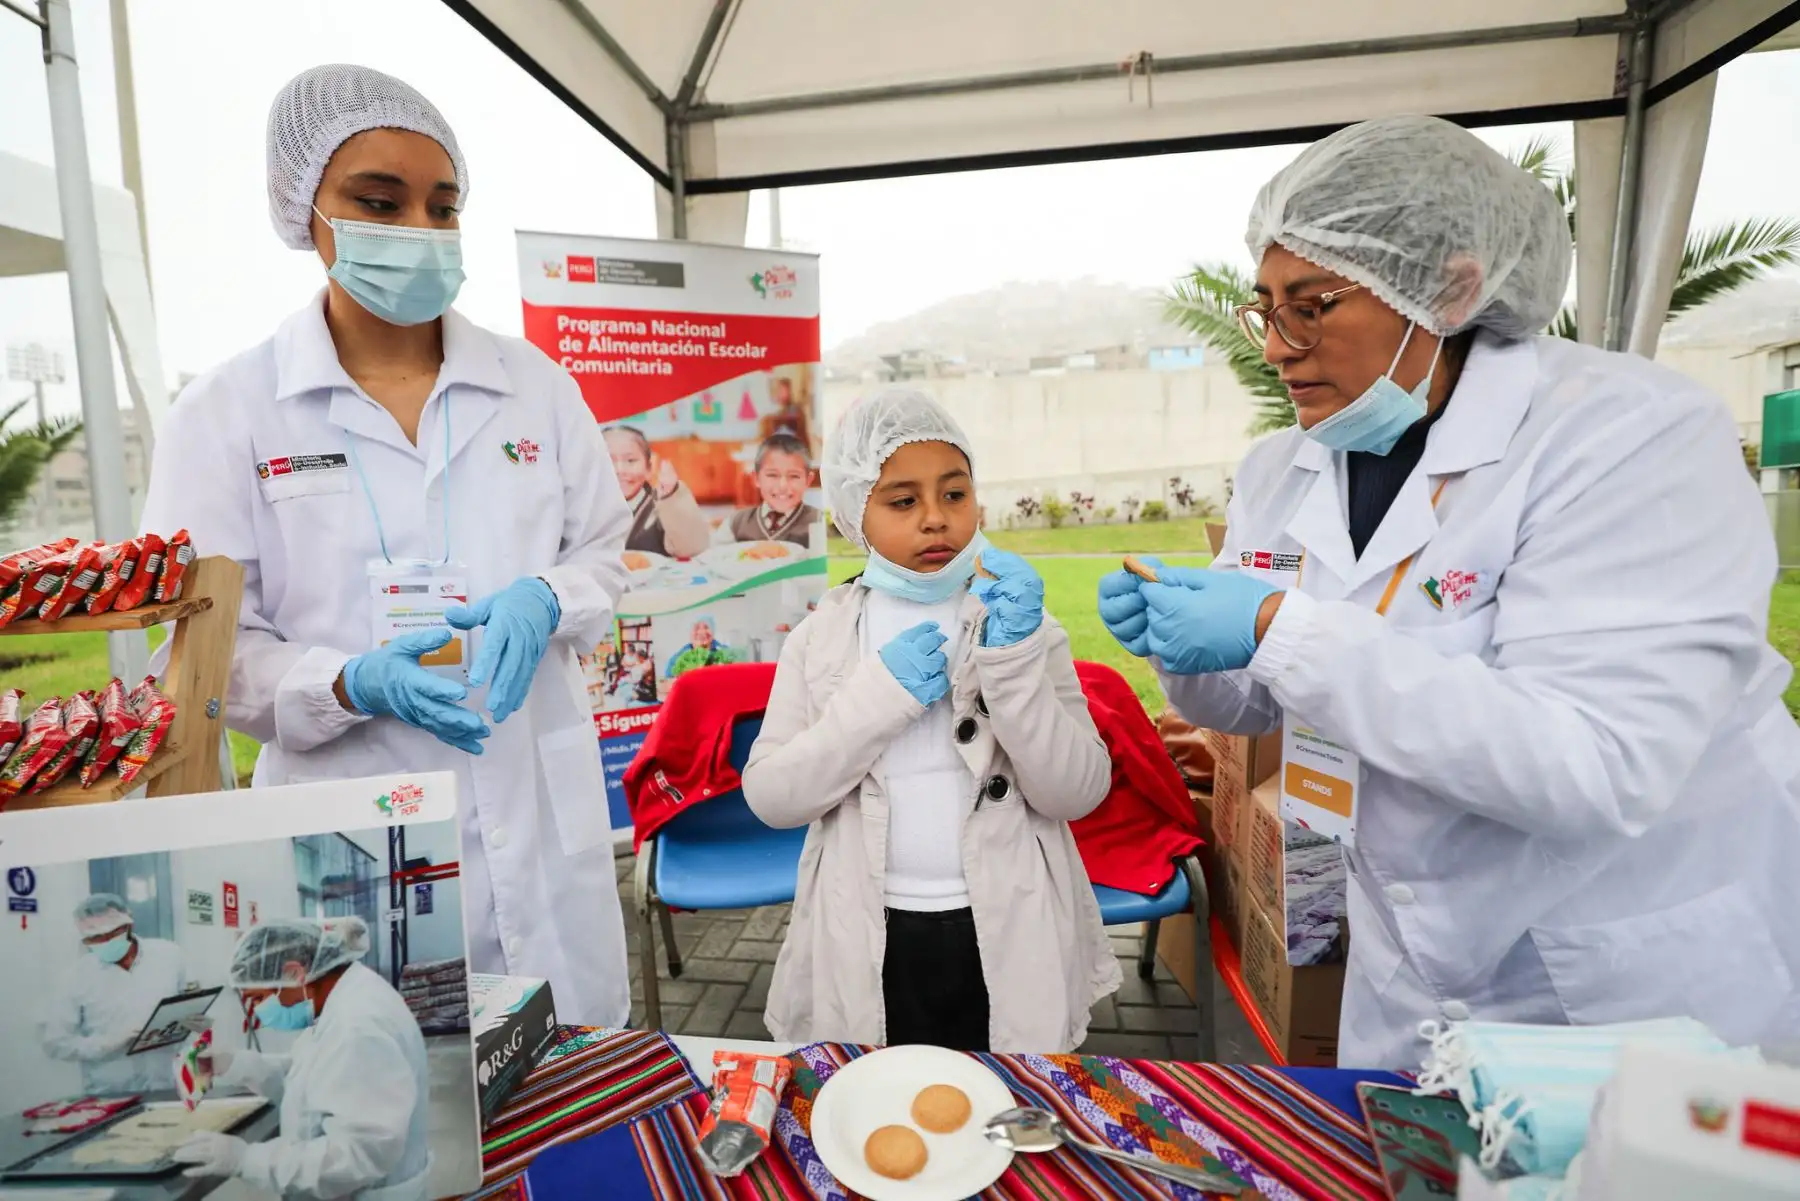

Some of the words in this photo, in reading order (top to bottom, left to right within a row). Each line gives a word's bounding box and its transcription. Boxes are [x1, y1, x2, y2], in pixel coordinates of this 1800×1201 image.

[569, 263, 593, 274] PERÚ
[557, 315, 647, 336] Programa
[651, 319, 726, 338] Nacional
[558, 335, 583, 352] de
[587, 337, 705, 357] Alimentación
[709, 342, 768, 359] Escolar
[560, 356, 673, 375] Comunitaria
[271, 461, 291, 471] PERÚ
[1302, 779, 1333, 797] STANDS
[490, 1025, 524, 1080] R&G
